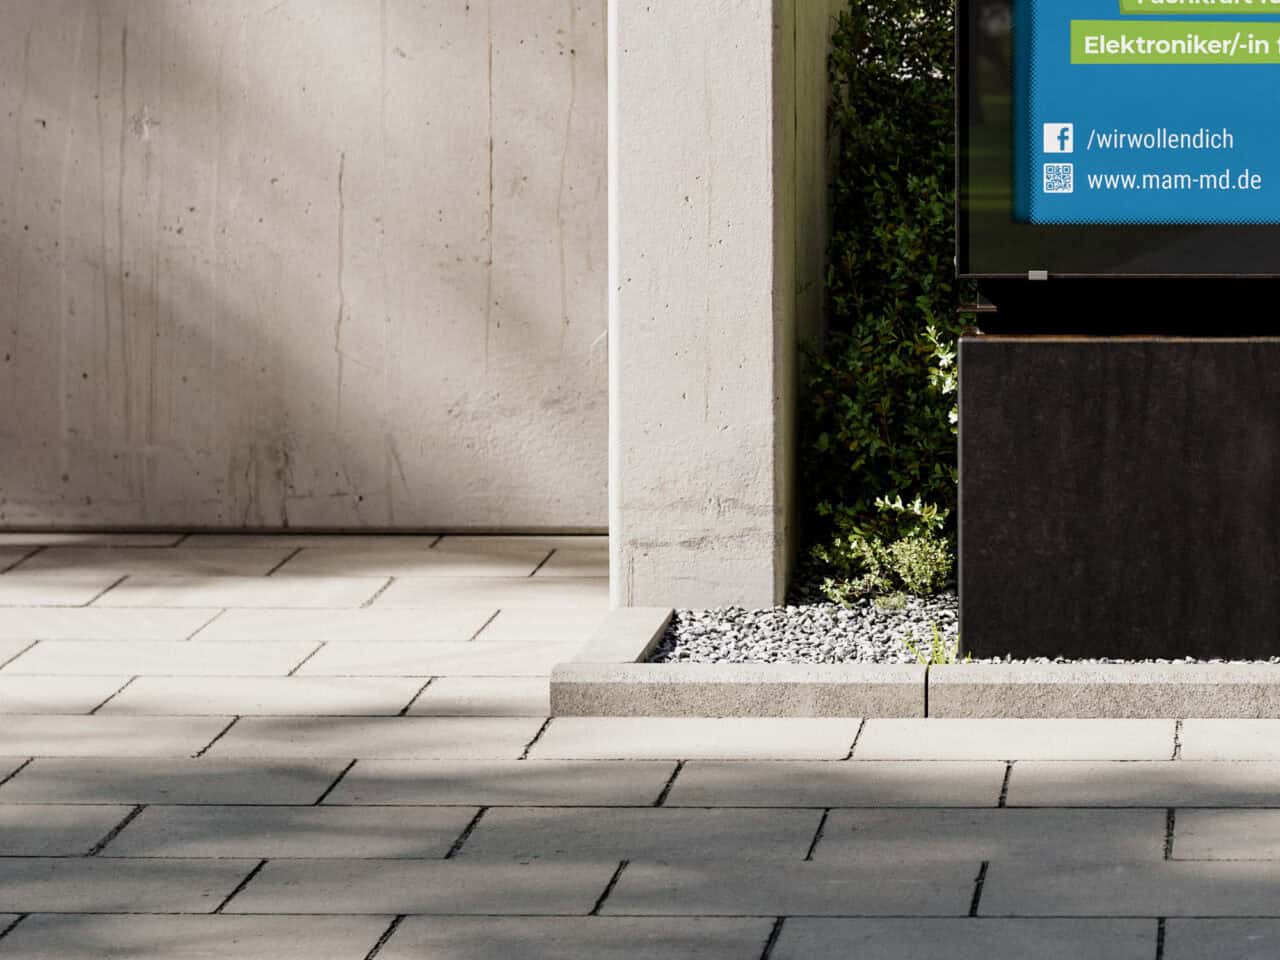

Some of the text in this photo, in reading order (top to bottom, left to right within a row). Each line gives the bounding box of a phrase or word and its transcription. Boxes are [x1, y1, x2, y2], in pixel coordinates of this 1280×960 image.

[1084, 33, 1269, 56] Elektroniker/-in
[1087, 127, 1234, 150] /wirwollendich
[1087, 169, 1262, 190] www.mam-md.de
